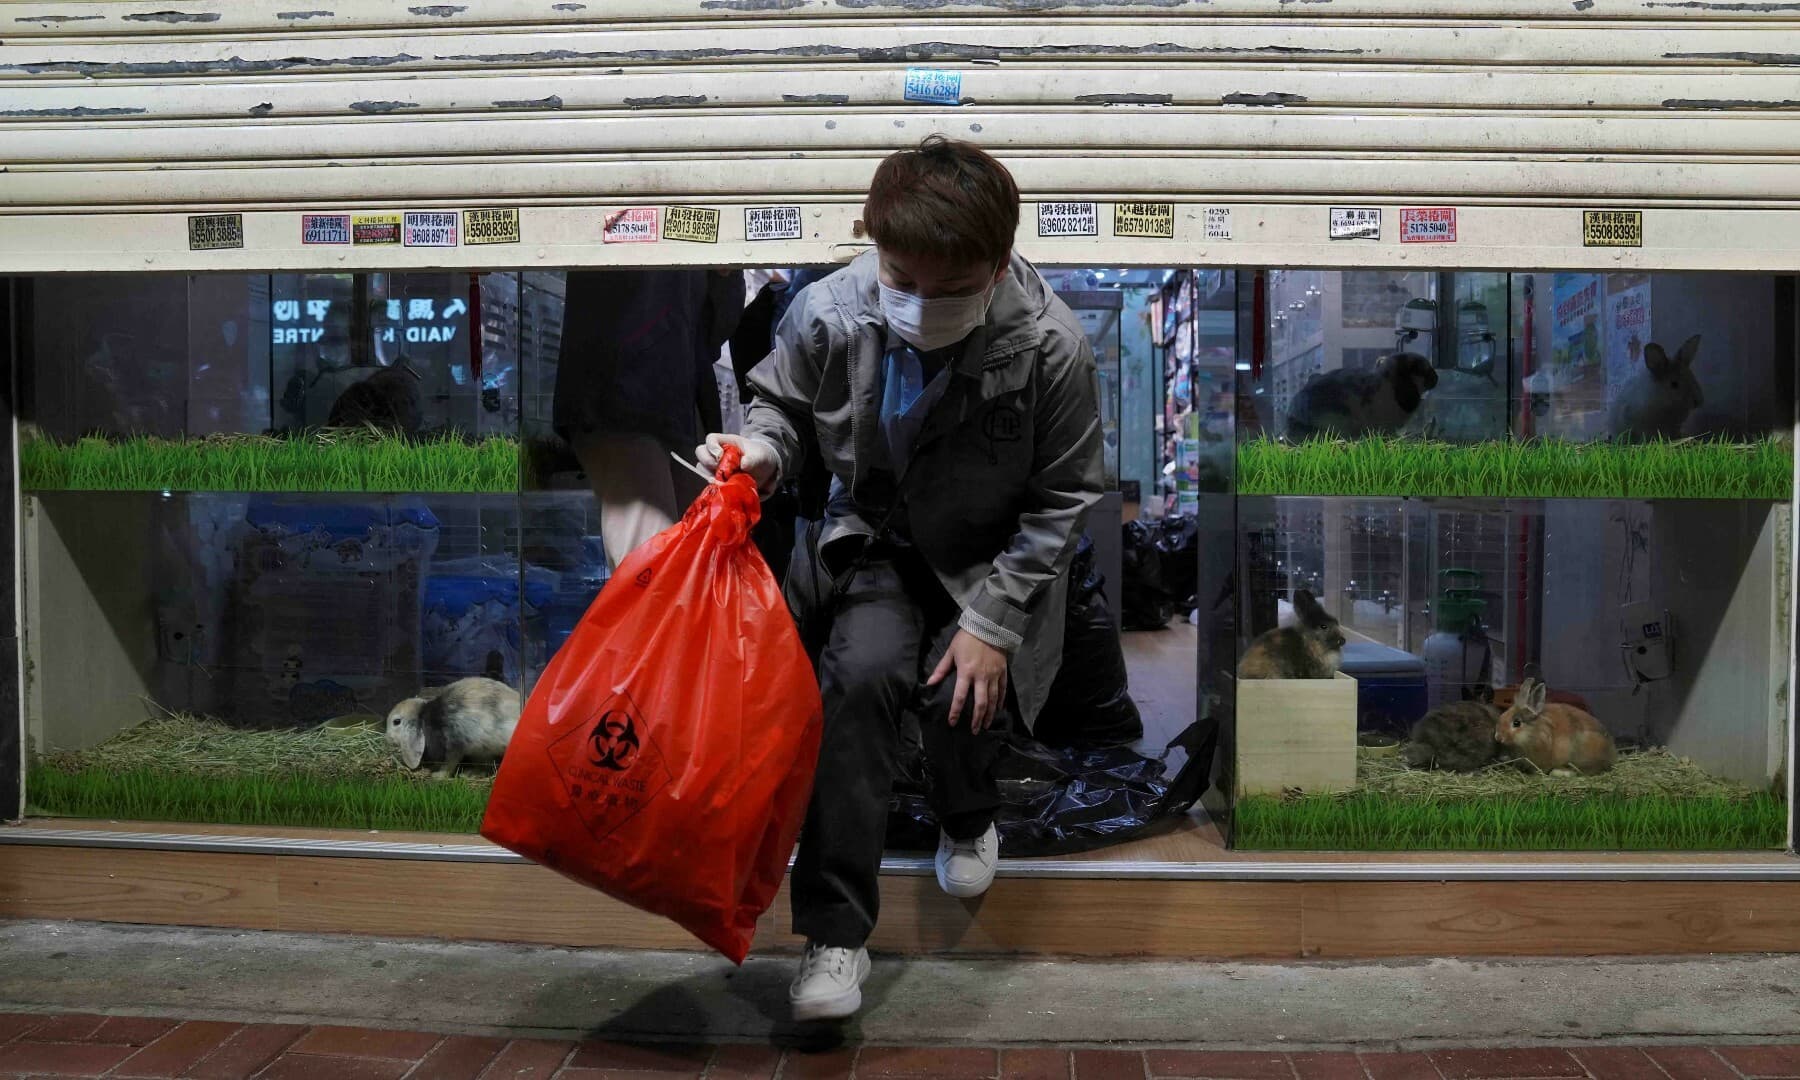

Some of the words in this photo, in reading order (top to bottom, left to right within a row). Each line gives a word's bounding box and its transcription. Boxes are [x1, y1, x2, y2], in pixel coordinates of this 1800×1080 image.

[907, 82, 931, 96] 5416
[933, 85, 957, 97] 6284
[1208, 208, 1230, 216] 0293
[470, 222, 491, 238] 5508
[492, 220, 514, 236] 8393
[631, 223, 648, 233] 5040
[672, 219, 691, 233] 9013
[754, 221, 773, 232] 5166
[774, 220, 792, 231] 1012
[1047, 217, 1067, 232] 9602
[1067, 217, 1087, 232] 8212
[1123, 218, 1143, 232] 6579
[1144, 218, 1164, 234] 0136
[1410, 223, 1428, 233] 5178
[1429, 222, 1447, 233] 5040
[195, 228, 215, 243] 5500
[305, 230, 348, 242] 69111711
[412, 229, 430, 243] 9608
[431, 229, 449, 243] 8971
[1590, 224, 1612, 239] 5508
[1613, 224, 1636, 240] 8393
[615, 776, 646, 793] WASTE
